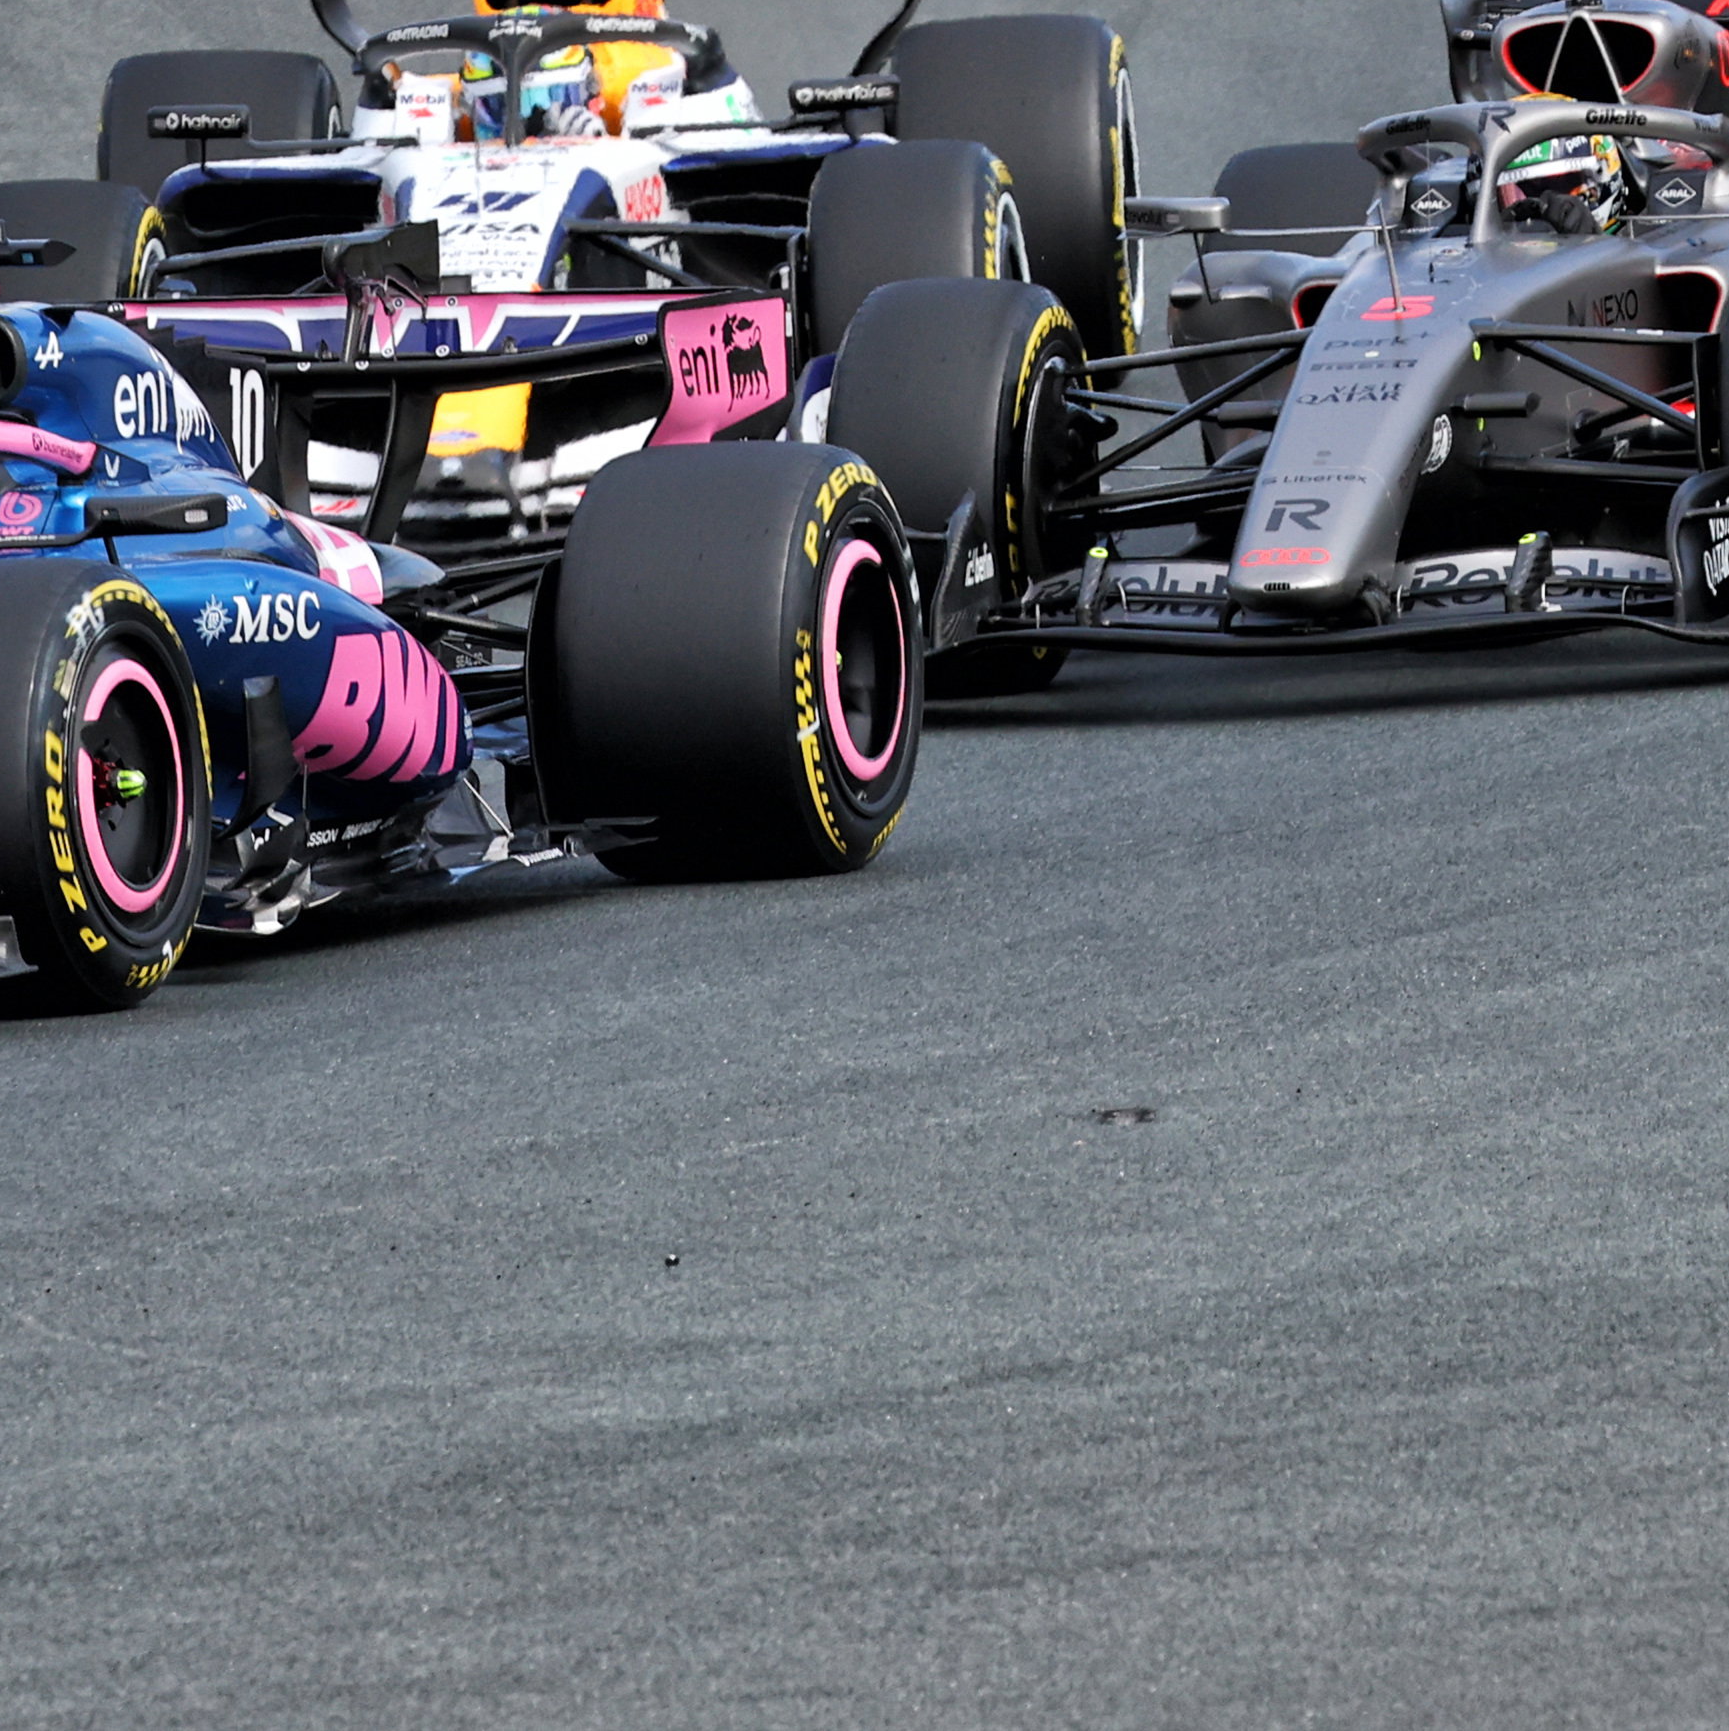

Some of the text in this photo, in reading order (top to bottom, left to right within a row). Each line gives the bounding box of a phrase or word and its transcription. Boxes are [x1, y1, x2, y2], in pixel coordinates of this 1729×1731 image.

[400, 93, 447, 105] Mobil
[1385, 116, 1430, 136] Gillette
[1585, 108, 1648, 127] Gillette
[1417, 199, 1450, 211] ARAL
[1661, 187, 1691, 200] ARAL
[1359, 296, 1436, 321] 5
[1593, 288, 1640, 328] NEXO
[678, 323, 719, 397] eni
[114, 348, 168, 439] eni
[1296, 390, 1403, 406] QATAR
[1333, 381, 1405, 395] visit
[229, 368, 265, 482] 10
[1282, 473, 1368, 485] Libertex
[803, 460, 876, 569] P ZERO
[1264, 498, 1331, 533] R
[229, 590, 322, 645] MSC
[45, 729, 110, 954] P ZERO
[306, 827, 339, 849] SSION
